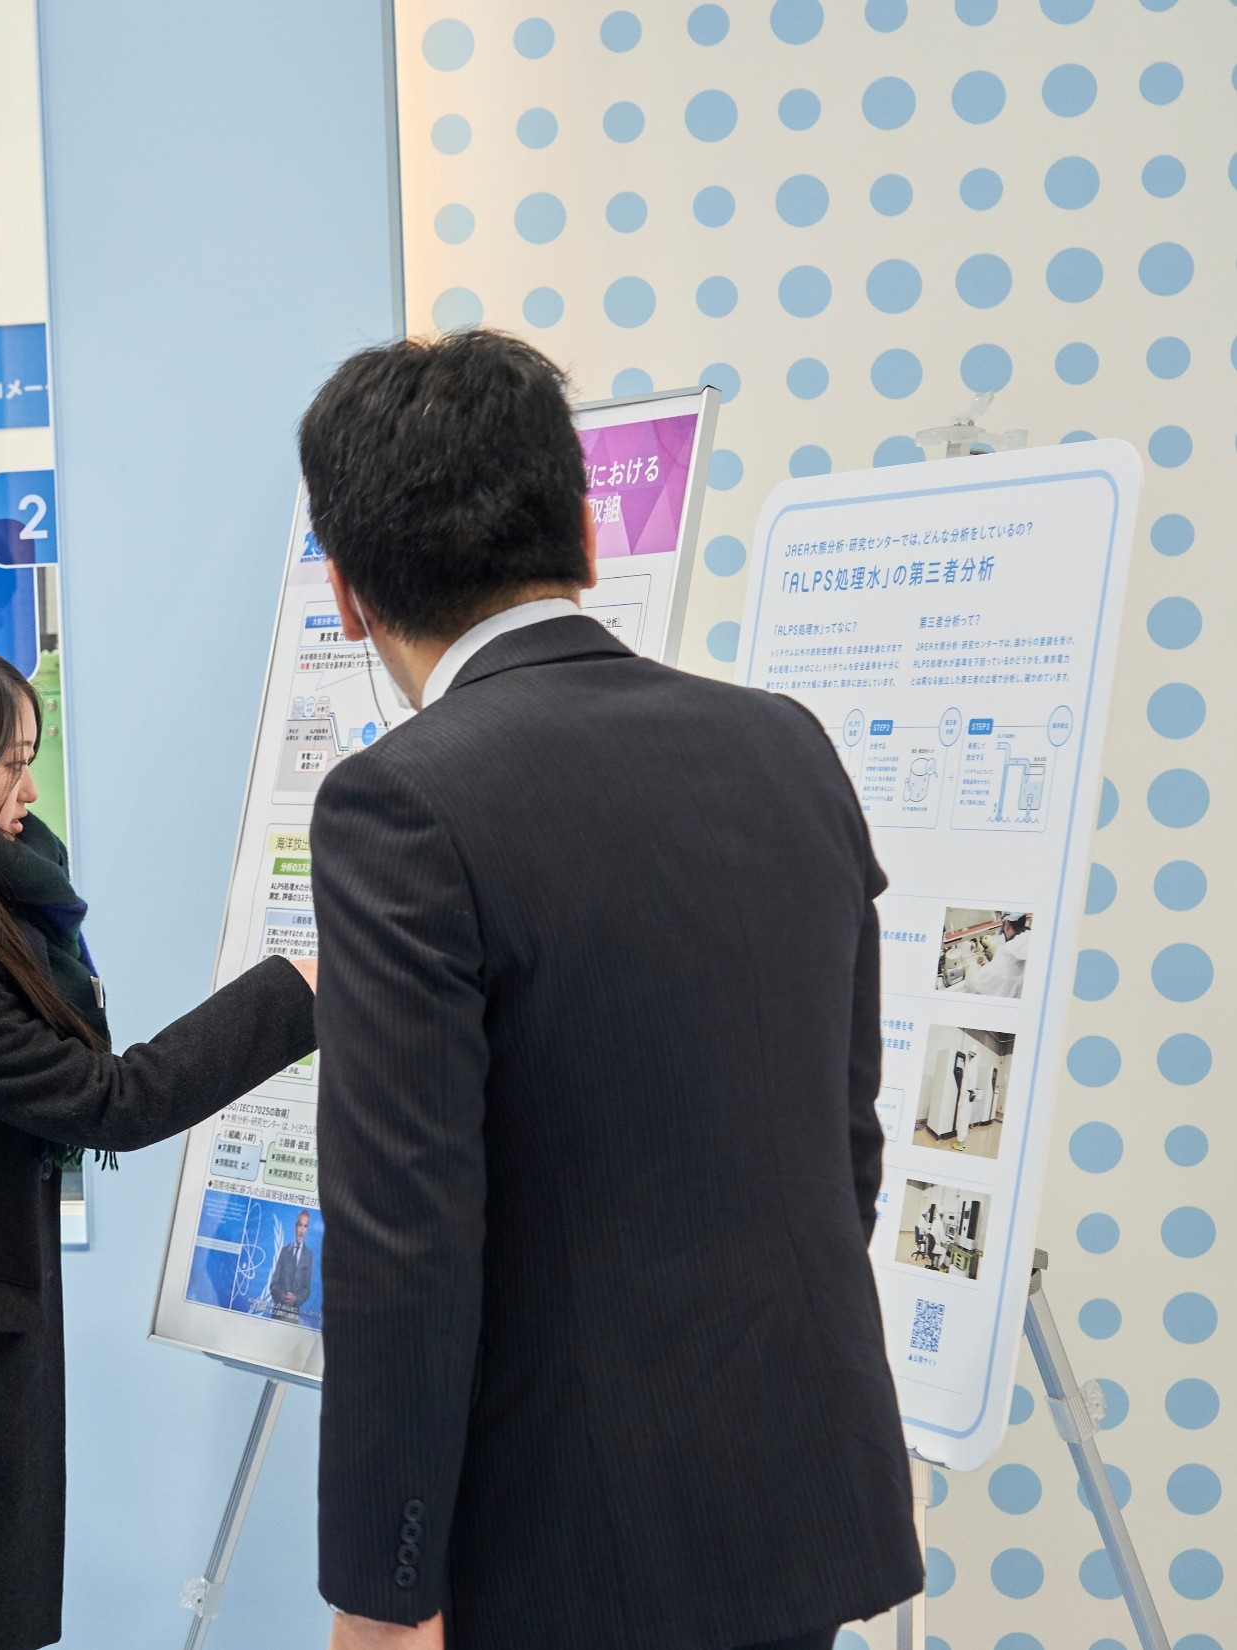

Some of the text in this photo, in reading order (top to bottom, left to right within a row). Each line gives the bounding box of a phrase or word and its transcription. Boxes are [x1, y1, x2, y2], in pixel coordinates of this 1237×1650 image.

[18, 493, 48, 540] 2
[781, 555, 995, 594] 「ALPS処理水」の第三者分析
